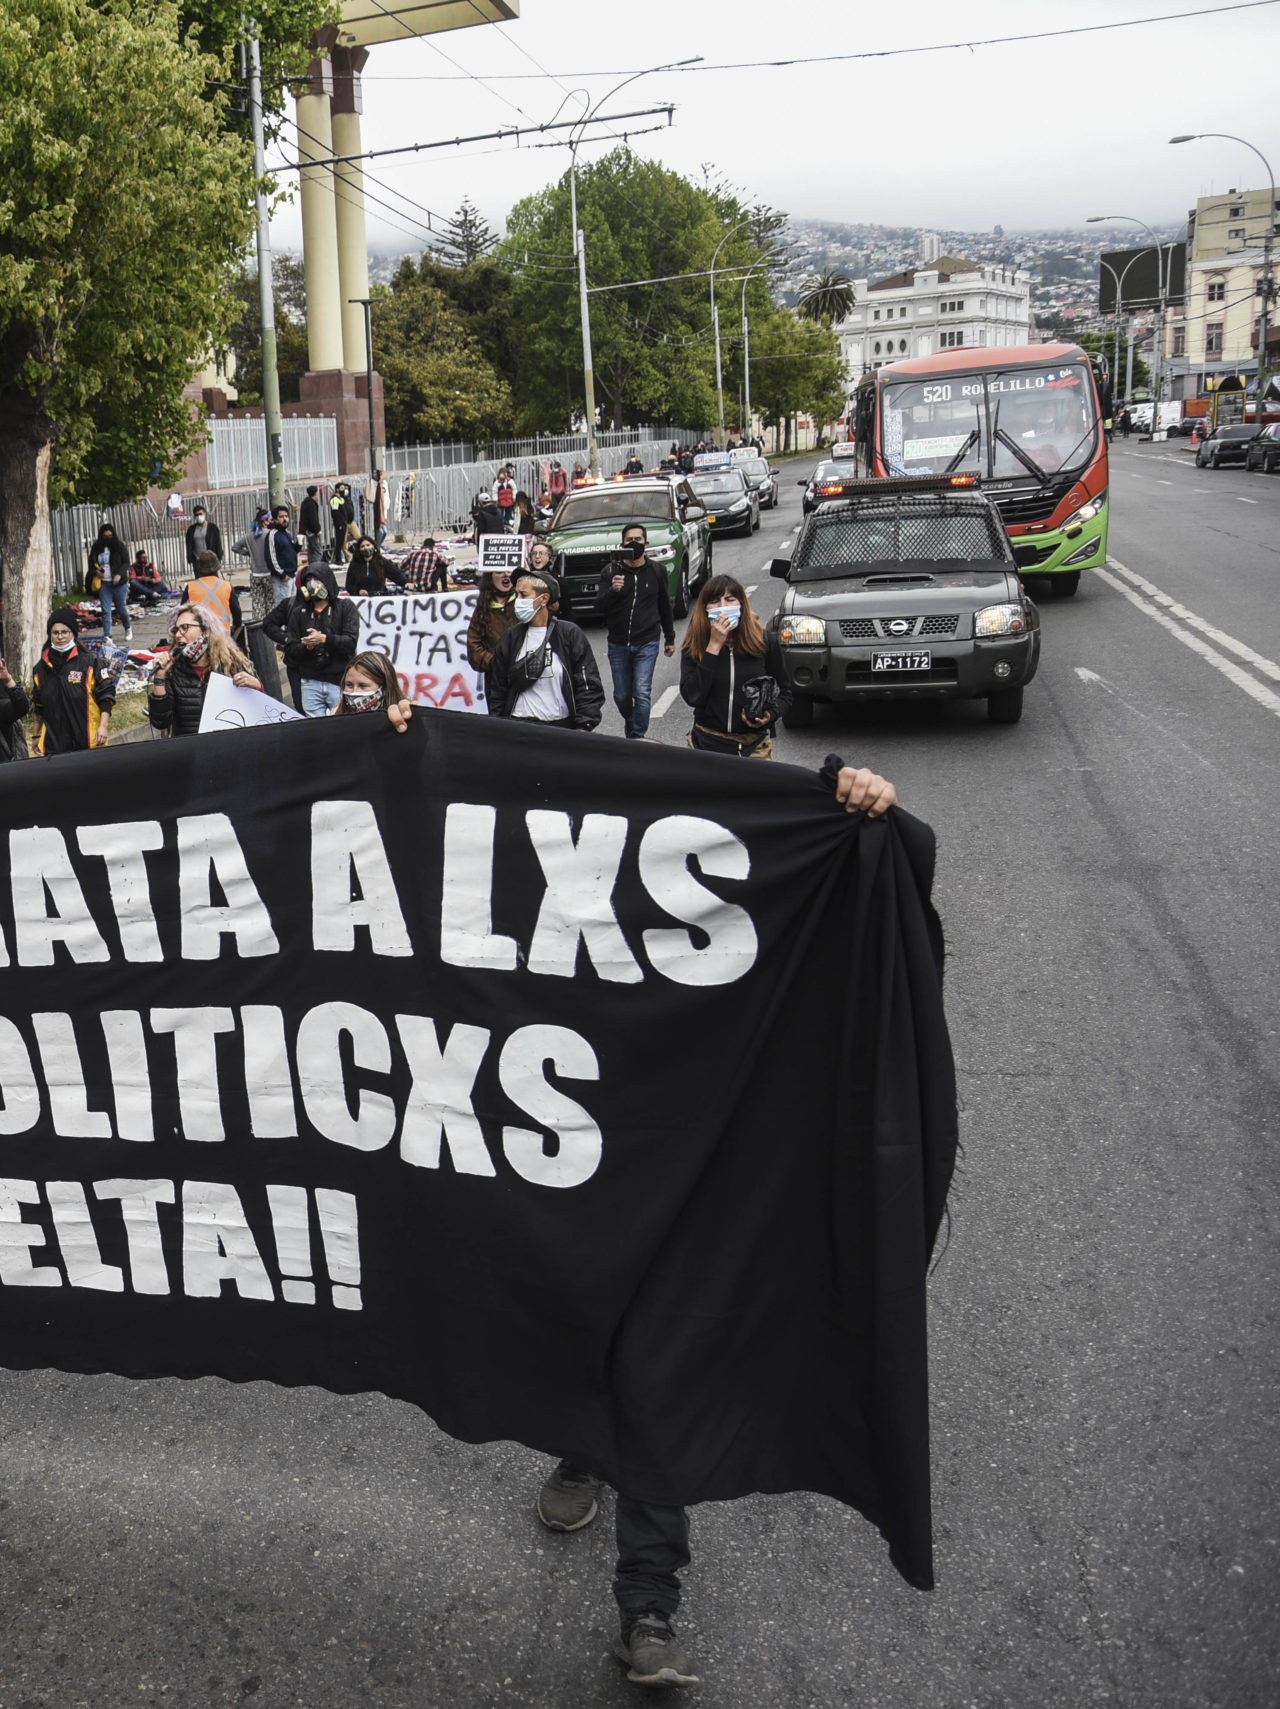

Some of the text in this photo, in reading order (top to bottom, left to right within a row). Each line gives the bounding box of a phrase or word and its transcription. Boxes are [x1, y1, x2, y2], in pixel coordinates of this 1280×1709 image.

[923, 385, 951, 402] 520
[558, 545, 606, 554] CARABINEROS
[311, 800, 414, 957] A
[440, 803, 759, 987] LXS
